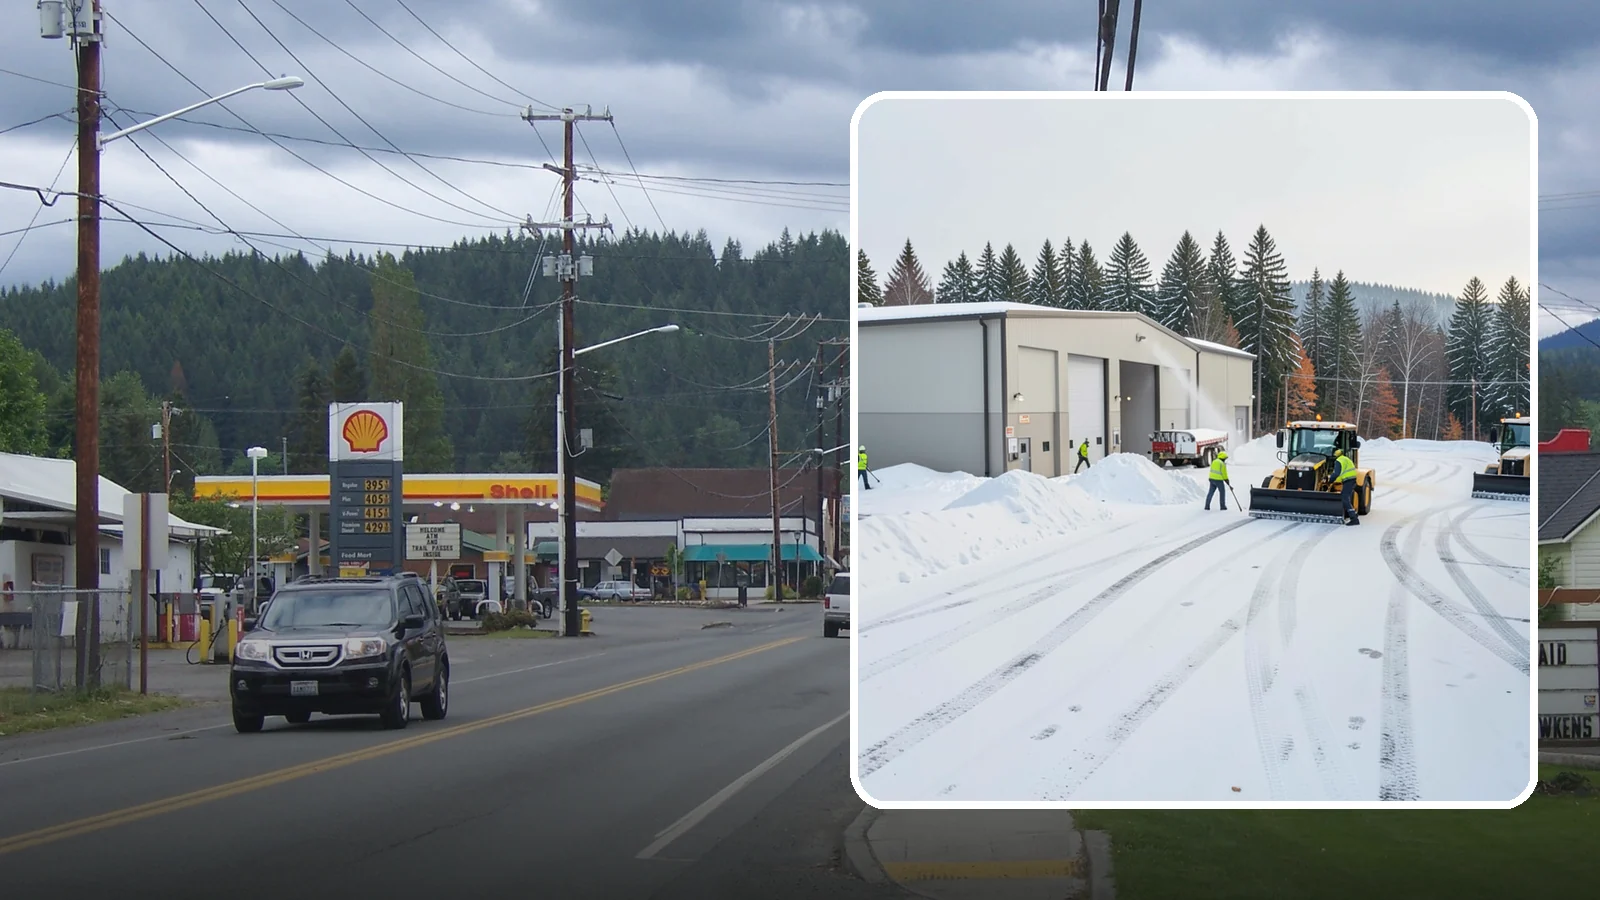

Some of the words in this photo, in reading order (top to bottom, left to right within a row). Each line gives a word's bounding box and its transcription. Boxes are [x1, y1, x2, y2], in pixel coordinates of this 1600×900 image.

[366, 480, 383, 490] 395
[490, 484, 547, 499] Shell
[366, 494, 383, 504] 405
[366, 508, 383, 518] 415
[366, 522, 383, 532] 429
